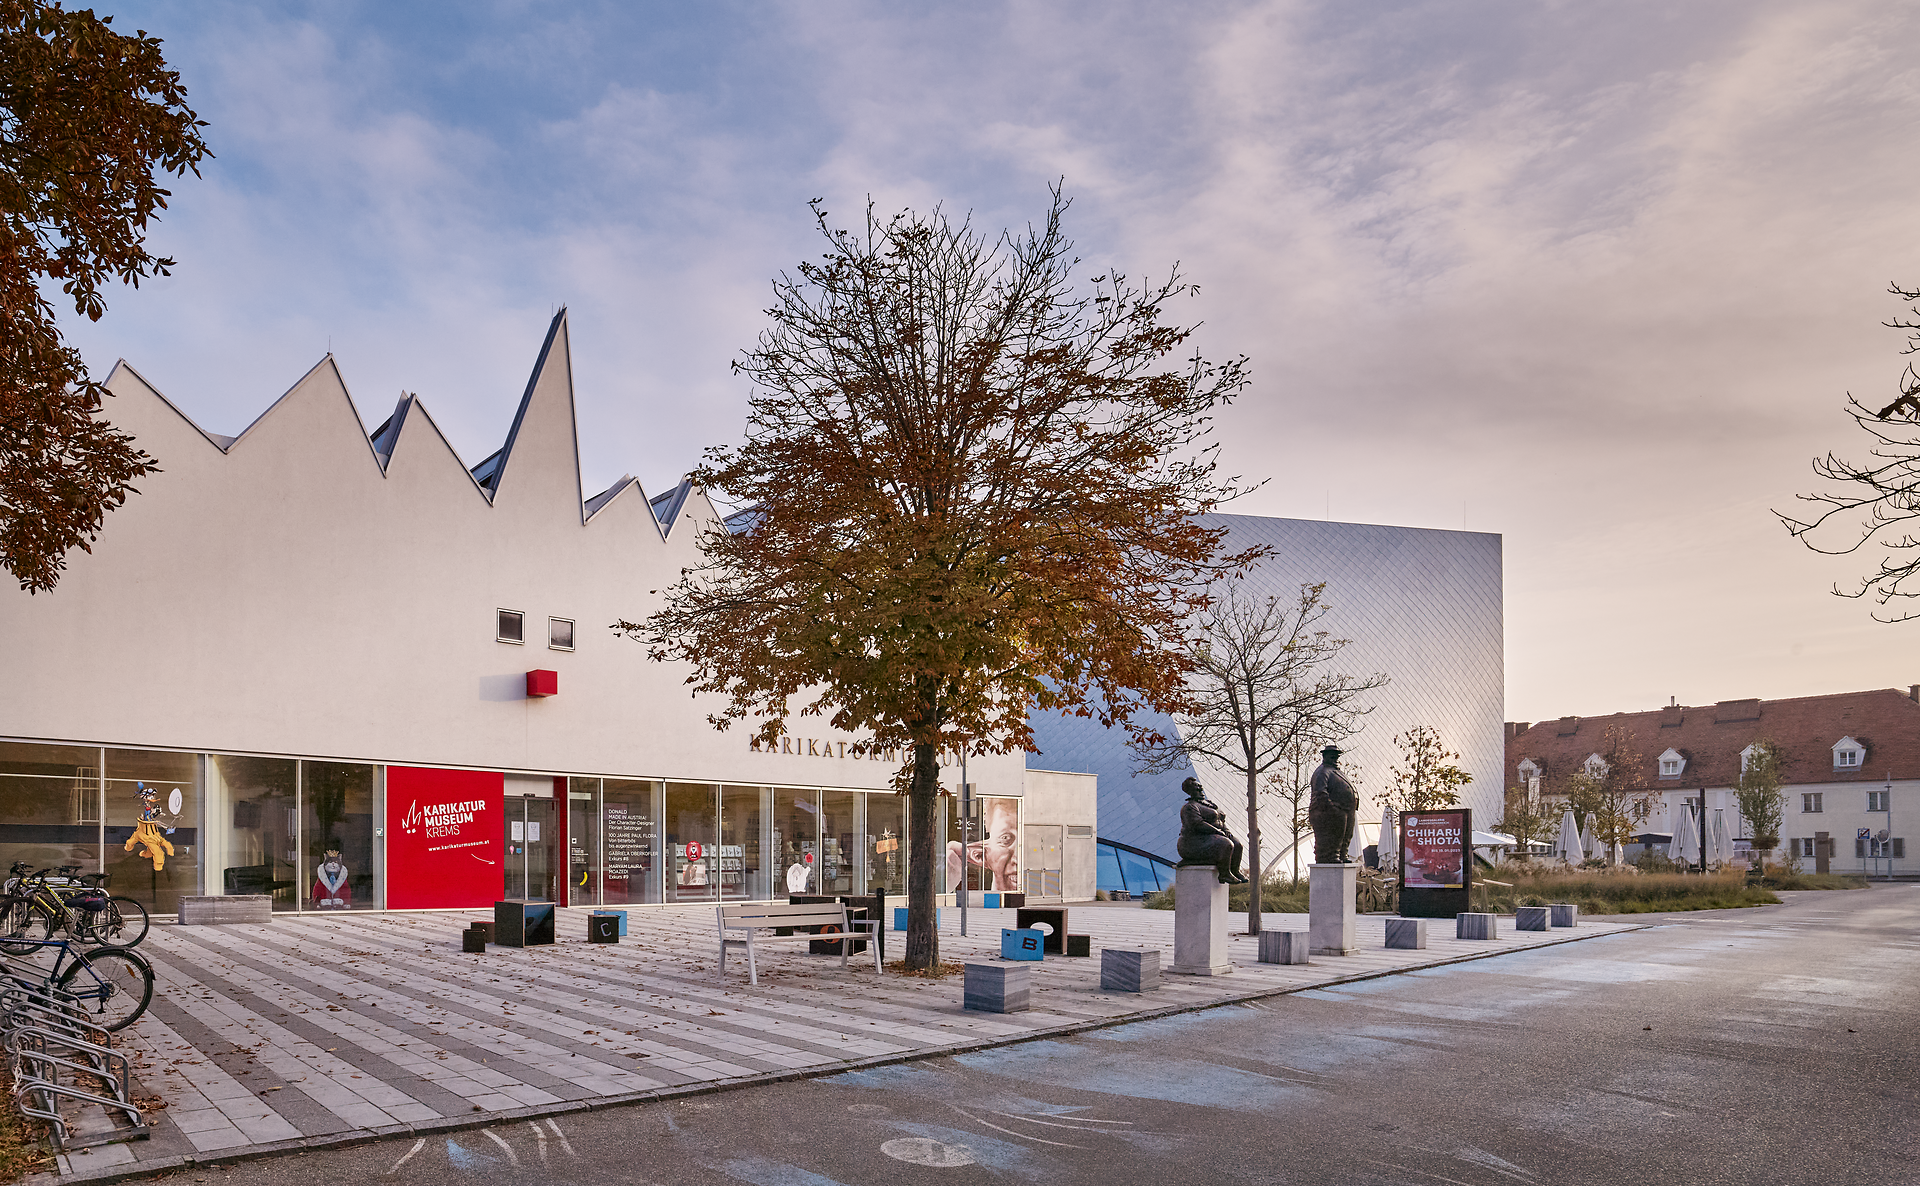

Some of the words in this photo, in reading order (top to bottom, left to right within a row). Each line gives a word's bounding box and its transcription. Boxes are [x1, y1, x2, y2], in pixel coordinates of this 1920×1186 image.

[750, 733, 968, 767] KARIKATMU
[423, 800, 486, 817] KARIKATUR
[424, 812, 474, 827] MUSEUM
[425, 824, 461, 839] KREMS
[1407, 828, 1461, 837] CHIHARU
[428, 840, 490, 852] www.karikaturmuseum.at
[1417, 837, 1461, 846] SHIOTA
[600, 922, 612, 937] C
[1022, 937, 1038, 951] B
